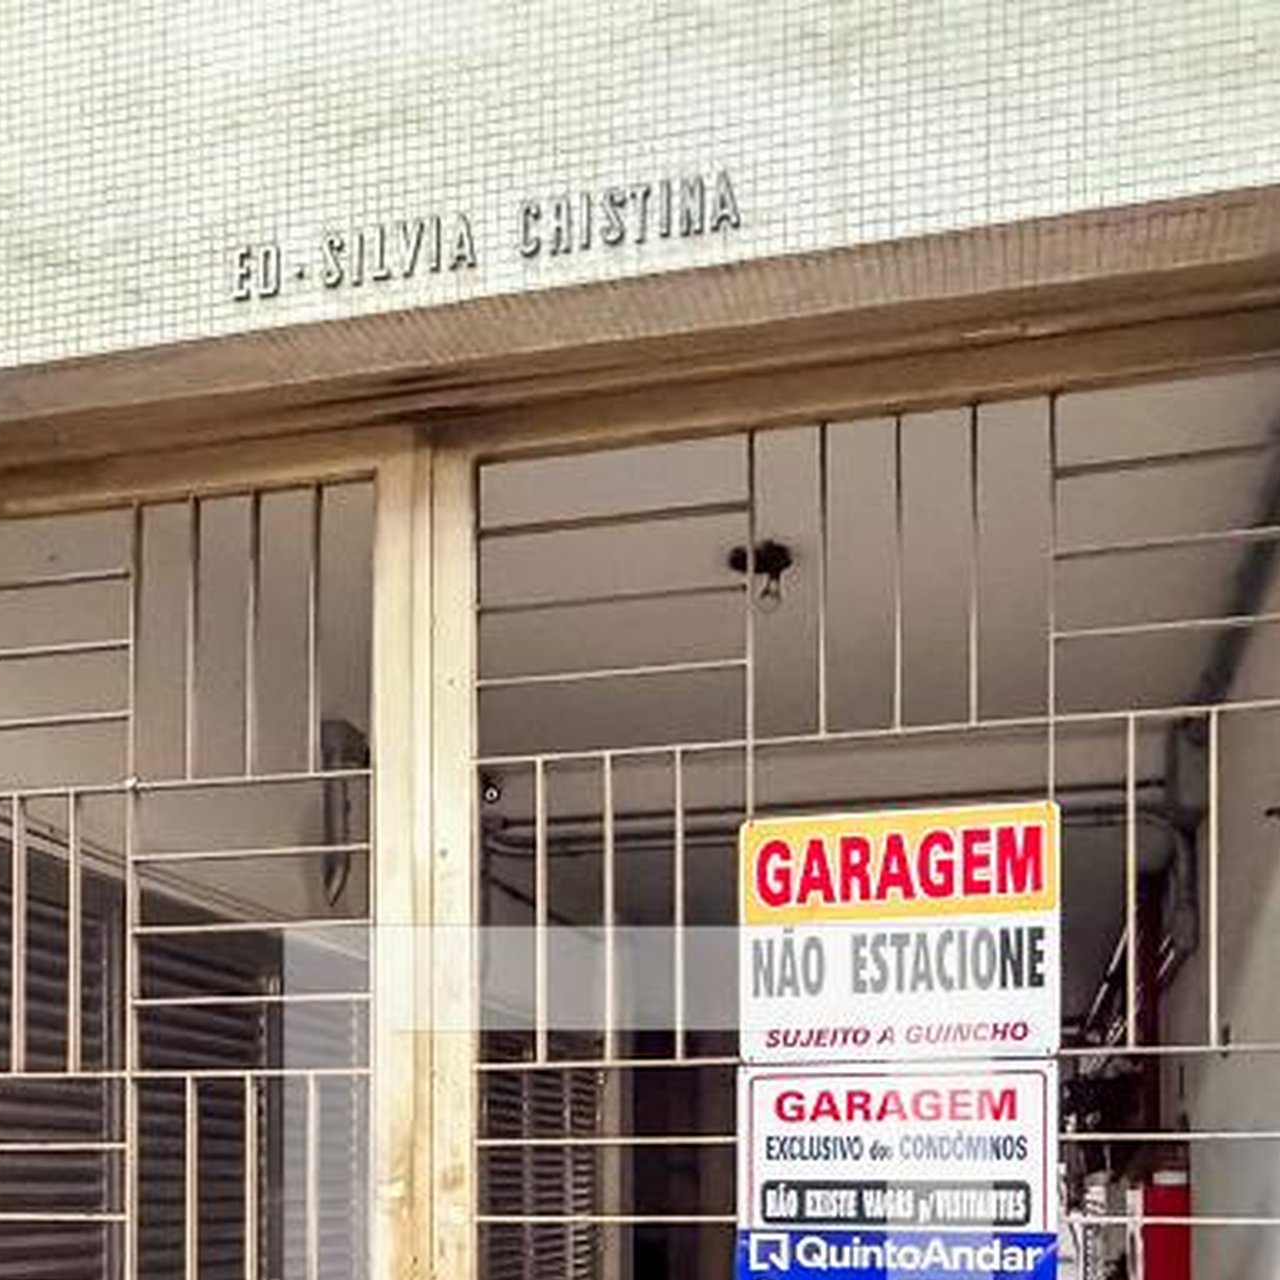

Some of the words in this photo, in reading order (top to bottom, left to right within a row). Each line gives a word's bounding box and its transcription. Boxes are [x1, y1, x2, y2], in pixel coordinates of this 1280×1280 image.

[519, 169, 742, 259] CRISTINA
[756, 825, 1043, 907] GARAGEM
[752, 928, 826, 999] NÃO
[851, 926, 1046, 994] ESTACIONE
[765, 1026, 871, 1048] SUJEITO
[876, 1026, 896, 1046] A
[905, 1022, 1029, 1045] GUINCHO
[774, 1088, 1018, 1123] GARAGEM
[765, 1135, 864, 1162] EXCLUSIVO
[795, 1235, 1046, 1272] QuintoAndar
